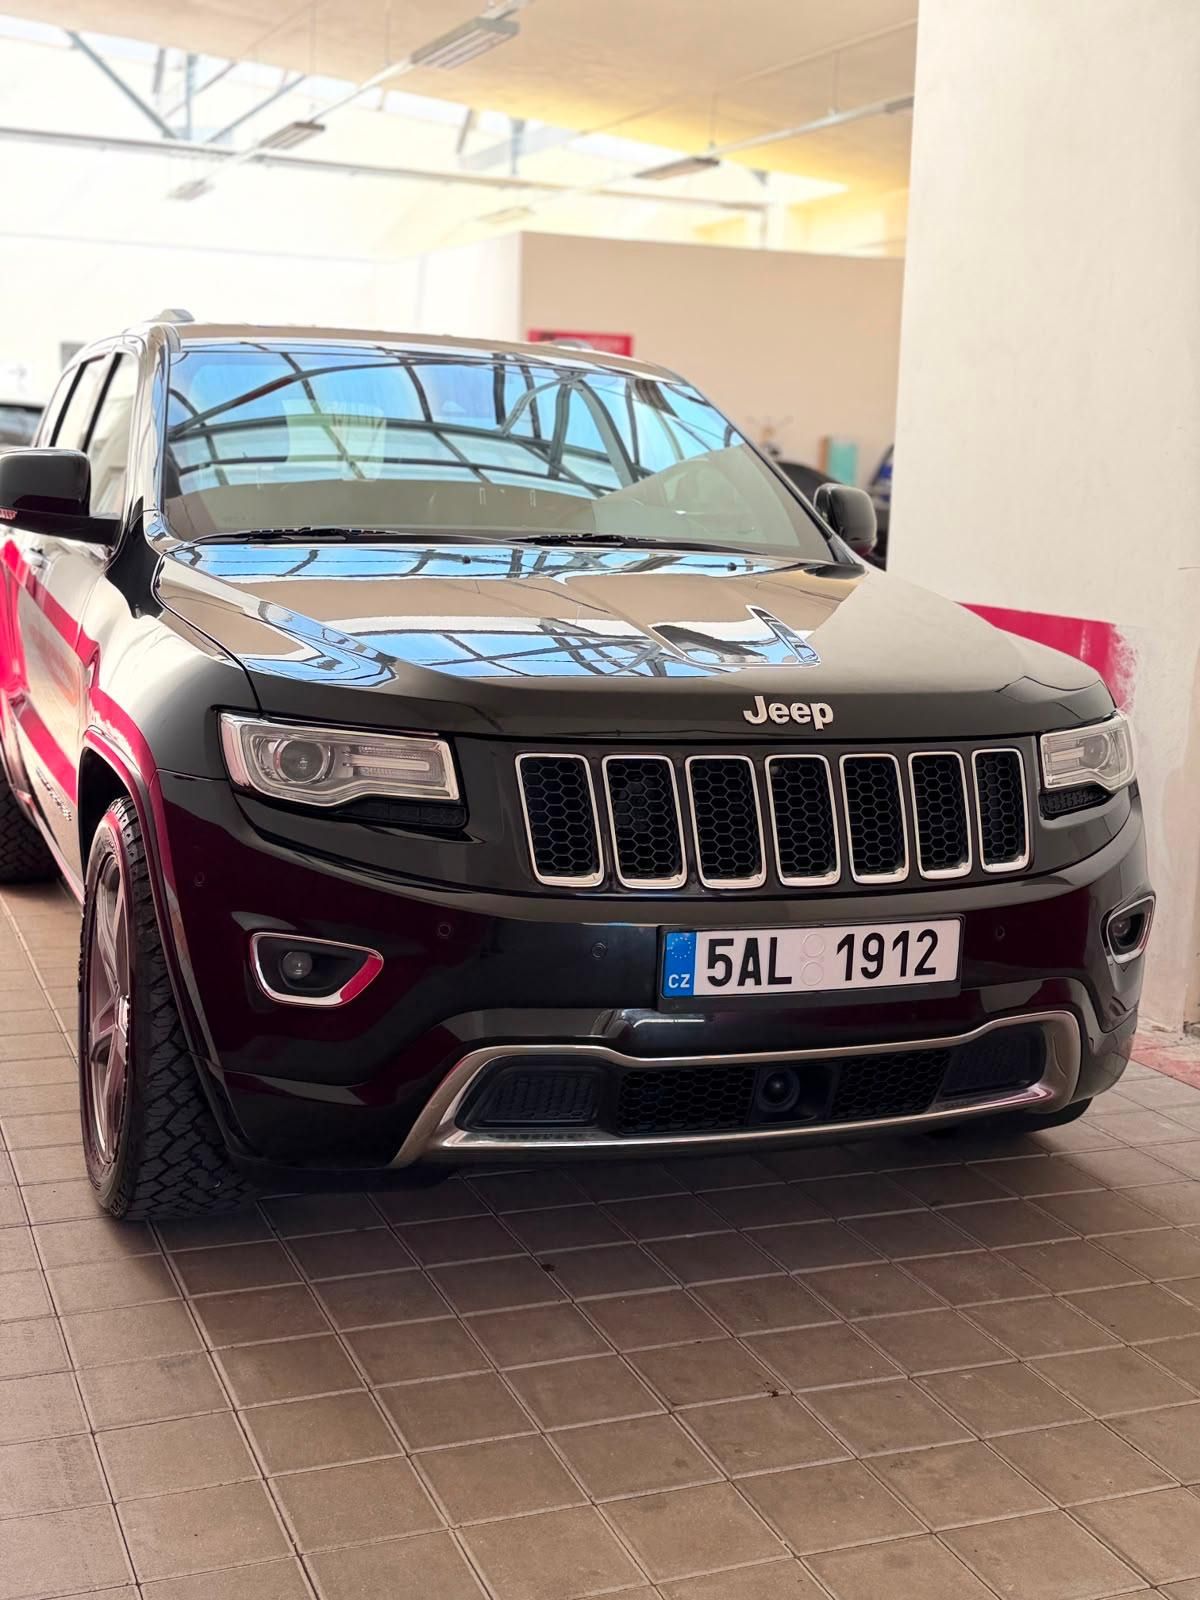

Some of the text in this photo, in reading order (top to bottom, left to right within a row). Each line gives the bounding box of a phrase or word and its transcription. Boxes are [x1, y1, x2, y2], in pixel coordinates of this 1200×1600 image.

[743, 695, 834, 730] Jeep
[707, 928, 938, 987] 5AL 1912
[668, 973, 690, 989] CZ
